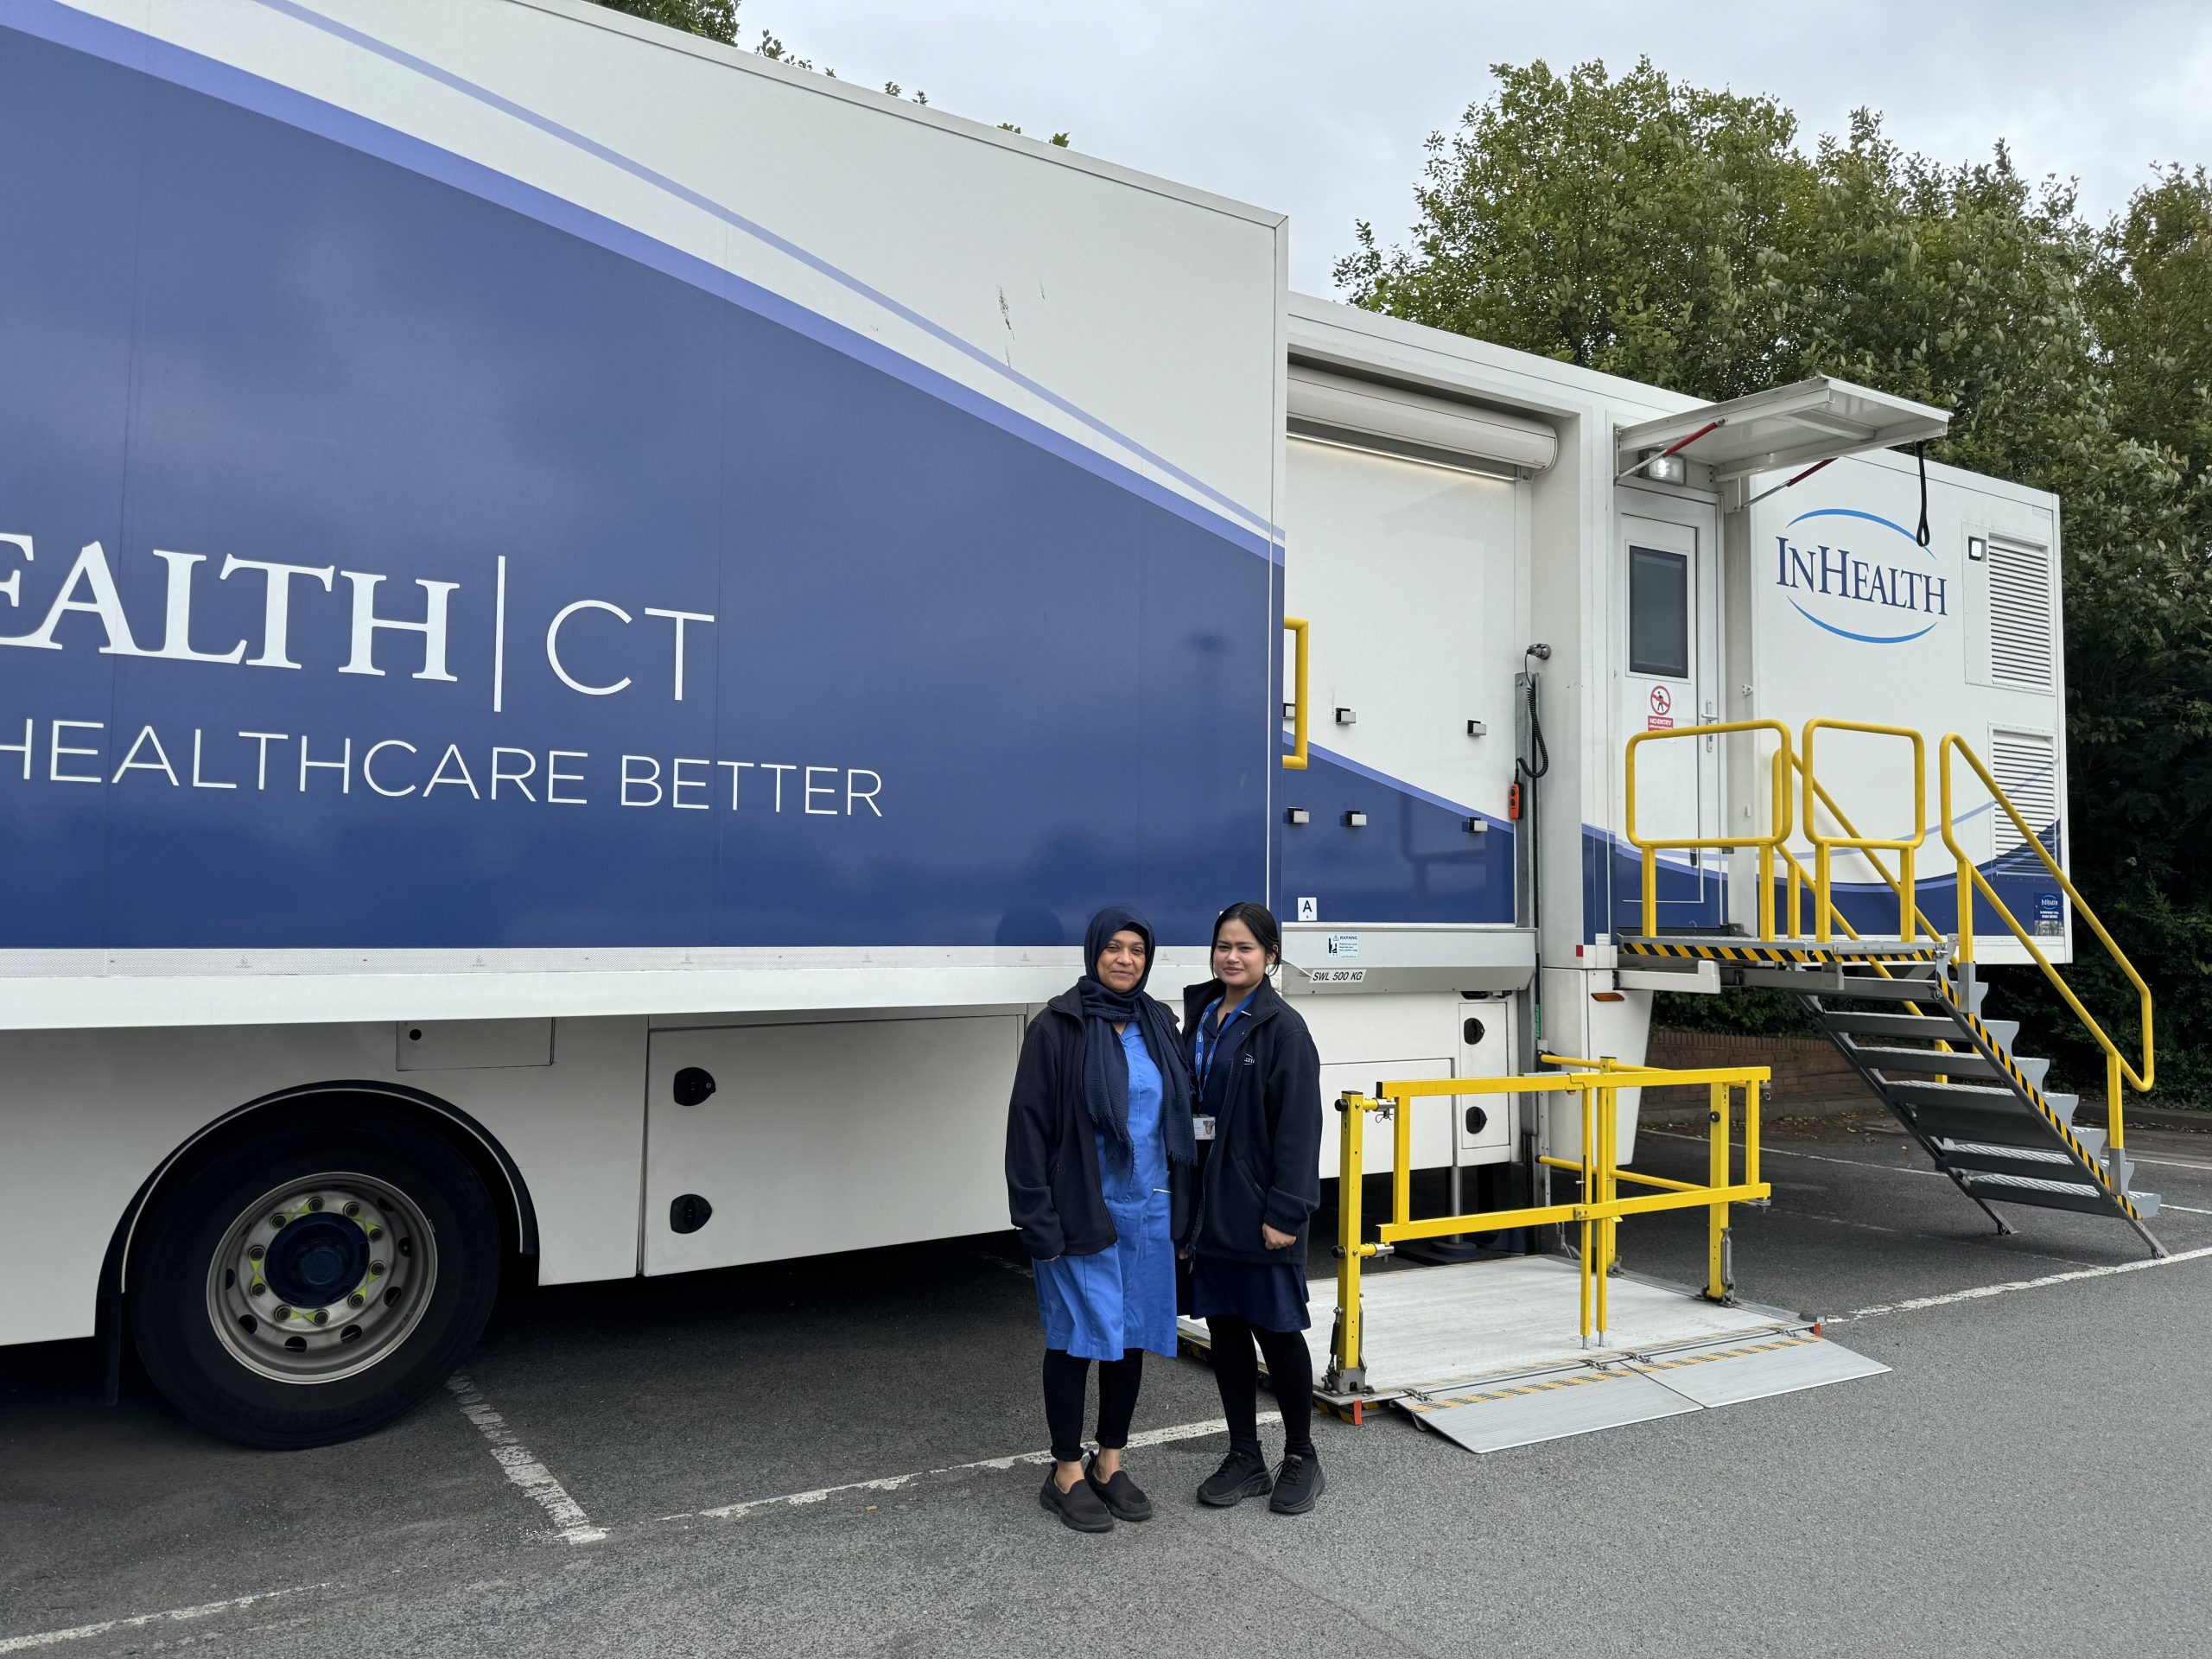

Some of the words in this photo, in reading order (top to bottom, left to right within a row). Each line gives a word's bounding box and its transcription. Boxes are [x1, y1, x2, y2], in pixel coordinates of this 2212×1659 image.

[1776, 536, 1948, 616] INHEALTH
[546, 600, 715, 701] CT
[620, 754, 883, 817] BETTER
[1302, 899, 1313, 912] A
[1313, 971, 1330, 982] SWL
[1332, 971, 1350, 982] 500
[1351, 971, 1363, 981] KG
